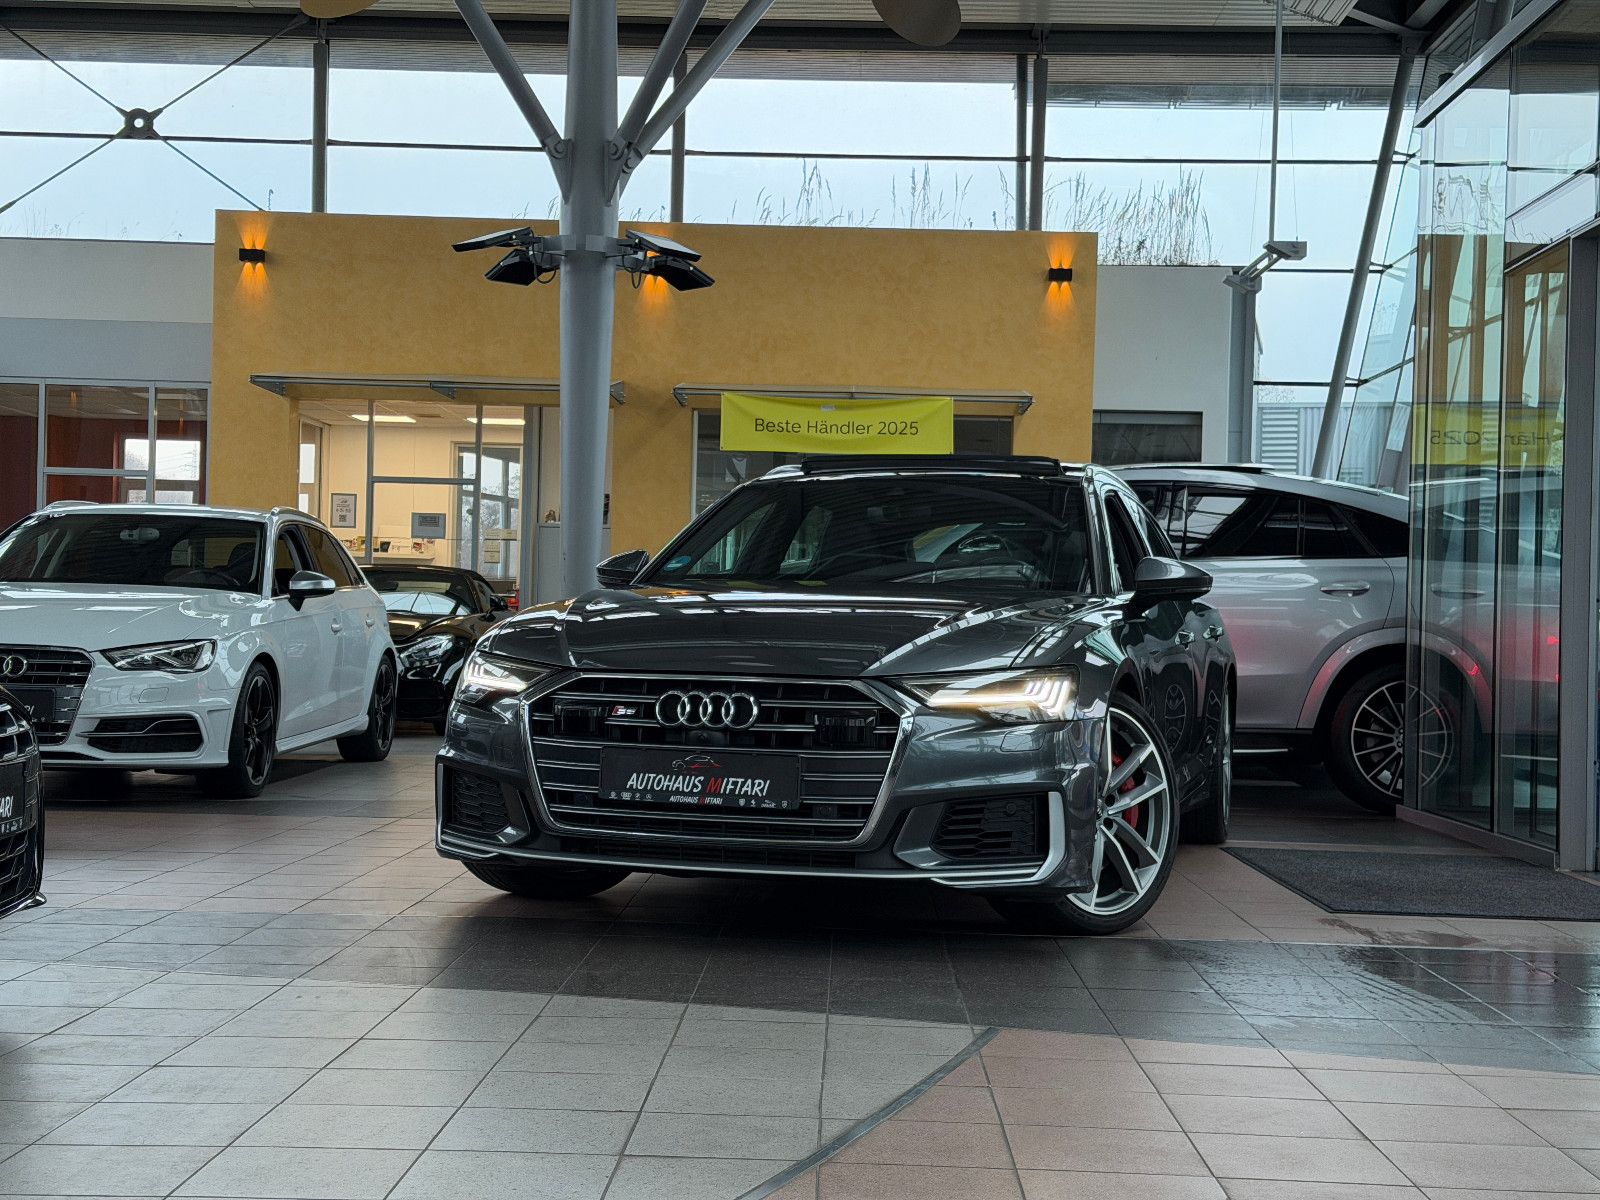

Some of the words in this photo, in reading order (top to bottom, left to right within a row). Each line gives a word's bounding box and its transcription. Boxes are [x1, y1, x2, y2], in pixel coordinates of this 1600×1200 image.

[754, 418, 801, 433] Beste
[807, 419, 873, 435] Händler
[877, 421, 919, 436] 2025
[626, 772, 704, 793] AUTOHAUS
[706, 777, 770, 797] MIFTARI
[669, 795, 699, 804] AUTOHAUS
